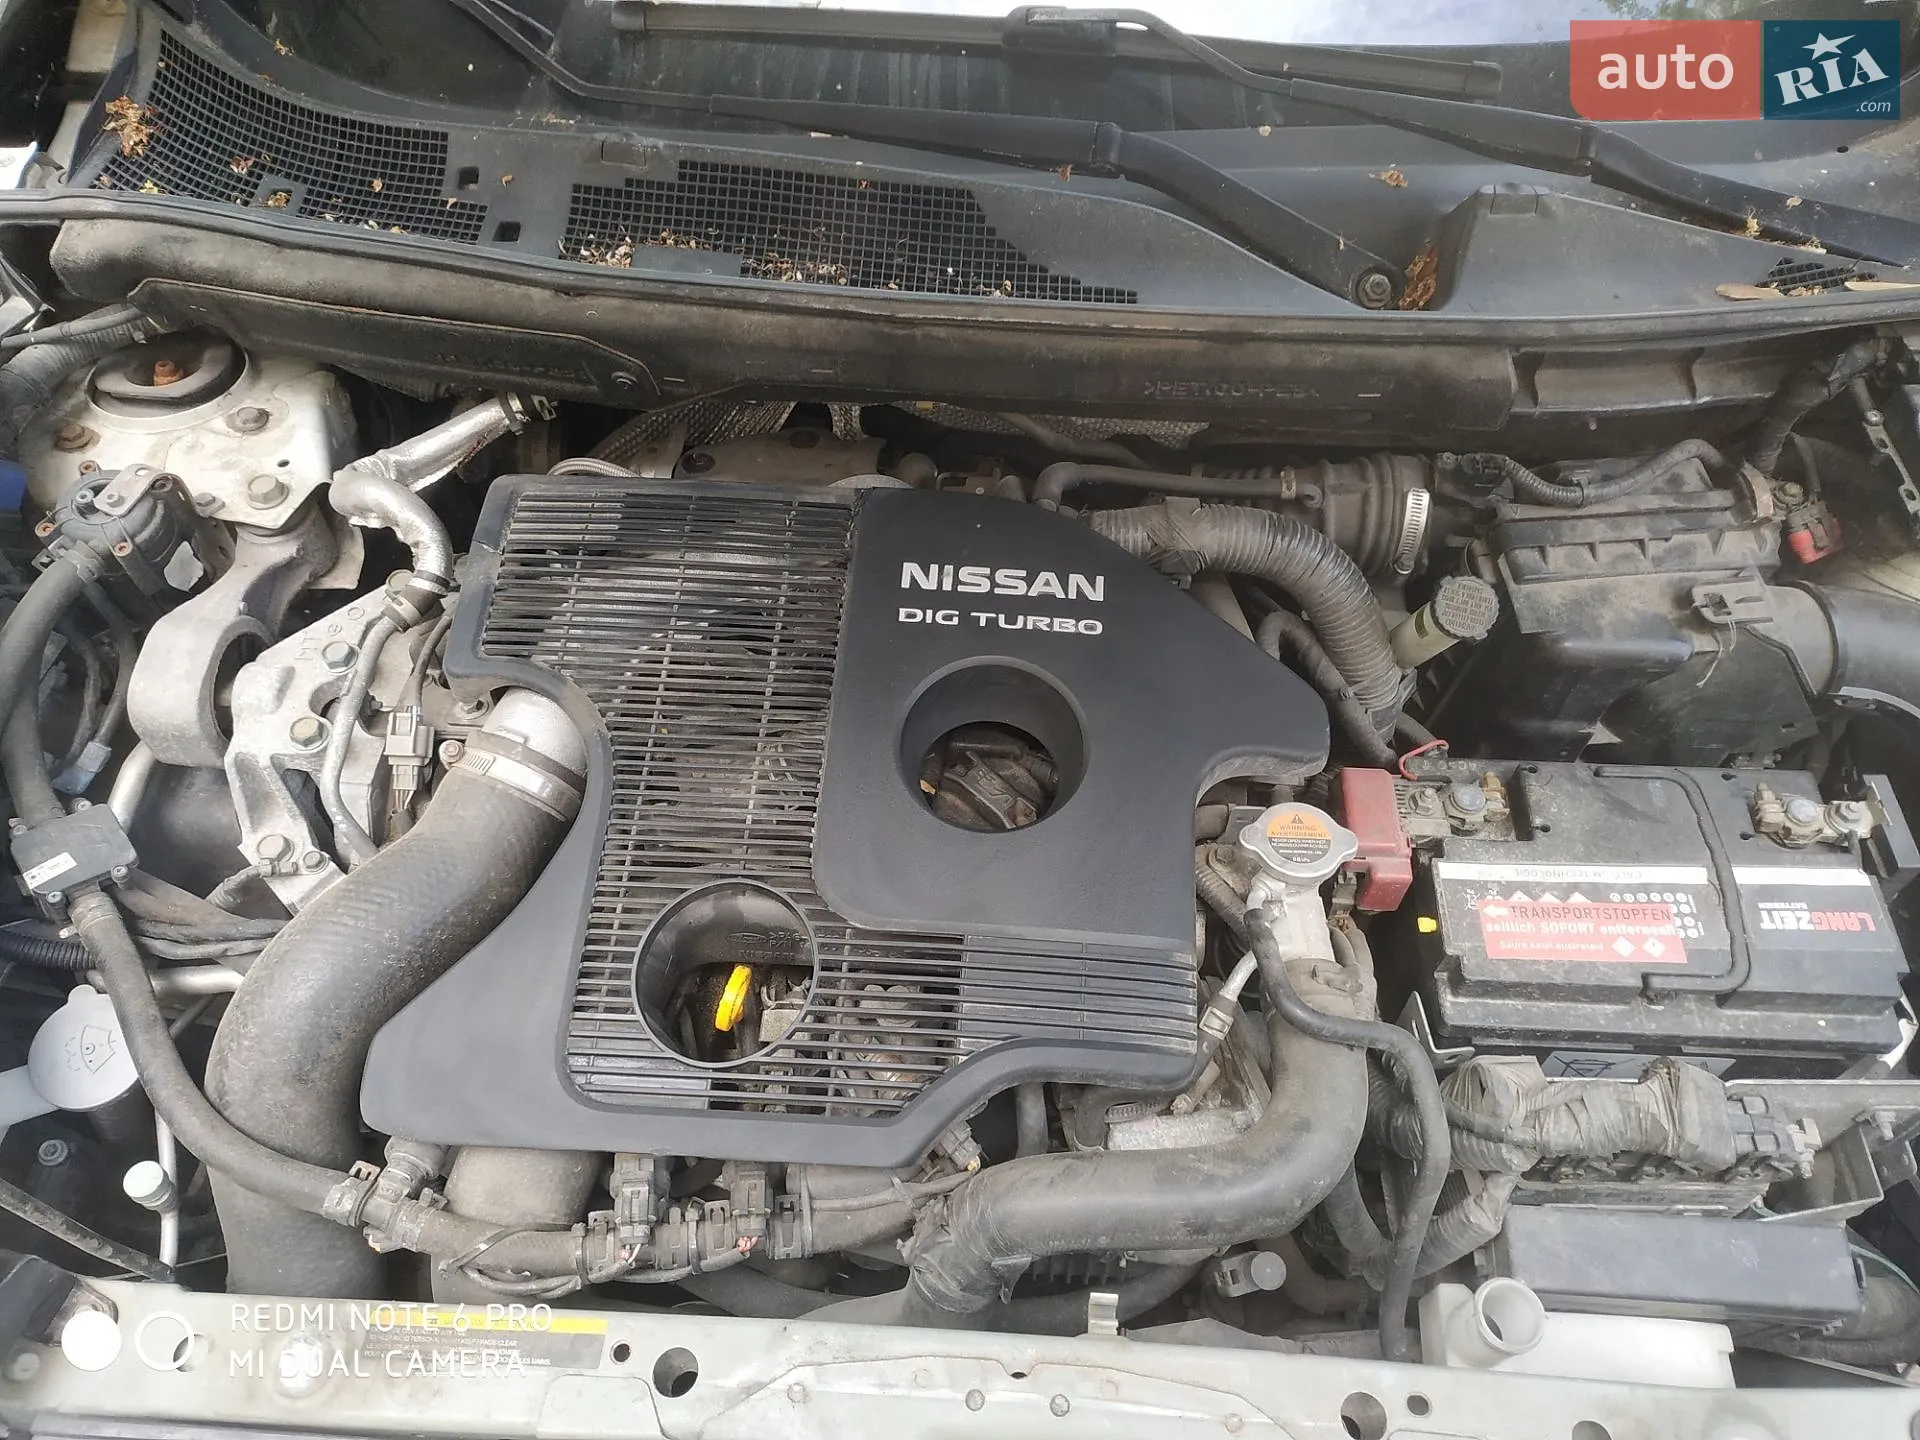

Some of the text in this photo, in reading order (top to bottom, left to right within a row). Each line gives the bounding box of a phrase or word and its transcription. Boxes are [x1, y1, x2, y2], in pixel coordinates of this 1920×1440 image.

[900, 561, 1105, 602] NISSAN
[898, 607, 1104, 636] DIG TURBO
[1510, 905, 1673, 921] TRANSPORTSTOPFEN
[1759, 910, 1877, 932] LANGZEIT
[1539, 920, 1598, 935] SOFORT
